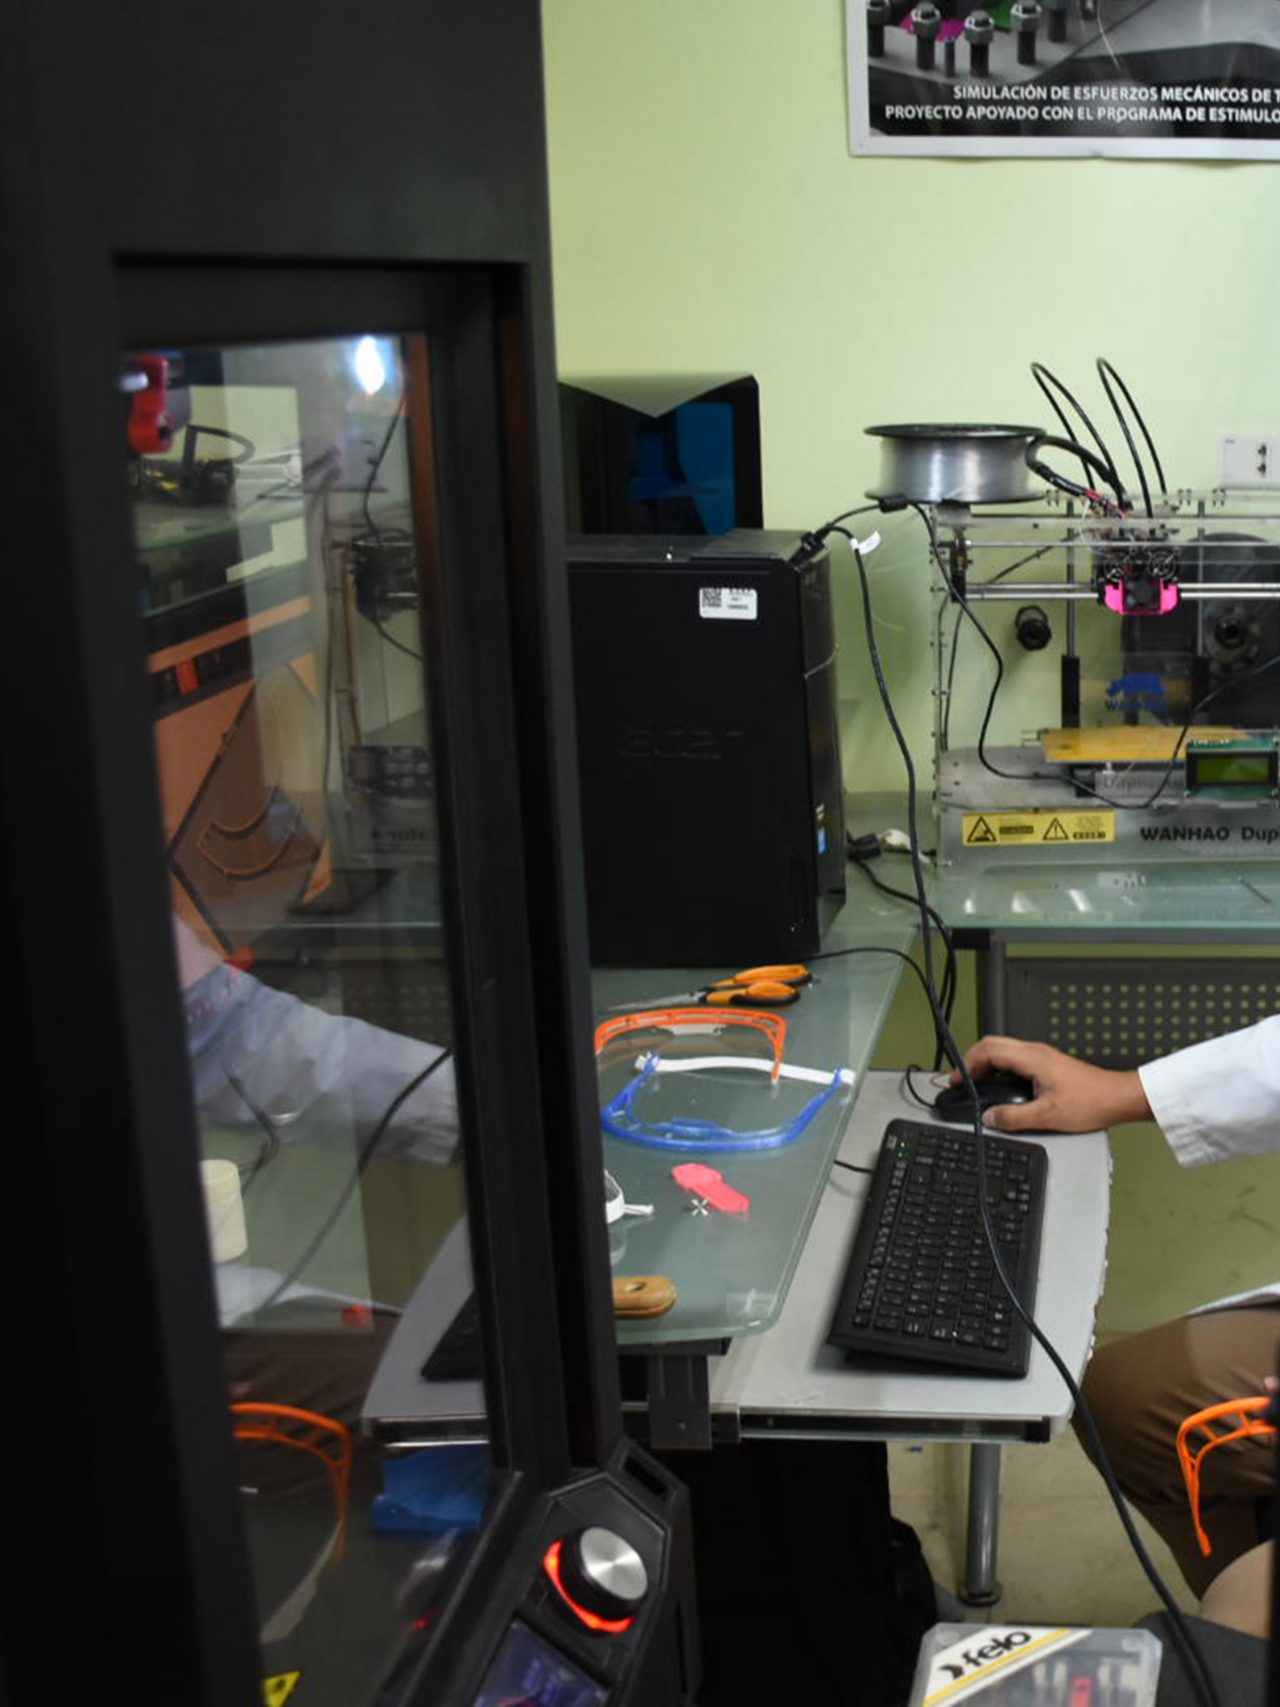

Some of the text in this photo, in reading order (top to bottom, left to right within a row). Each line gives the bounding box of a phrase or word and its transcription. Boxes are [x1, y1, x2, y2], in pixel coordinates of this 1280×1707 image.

[953, 84, 1047, 101] SIMULACIÓN
[1051, 86, 1070, 100] DE
[1074, 86, 1158, 101] ESFUERZOS
[1161, 85, 1249, 102] MECÁNICOS
[1251, 88, 1271, 103] DE
[885, 105, 963, 120] PROYECTO
[966, 105, 1039, 121] APOYADO
[1042, 106, 1074, 120] CON
[1077, 107, 1094, 121] EL
[1097, 106, 1183, 122] PROGRAMA
[1185, 107, 1206, 122] DE
[1139, 825, 1231, 842] WANHAO
[962, 1632, 1032, 1666] felo
